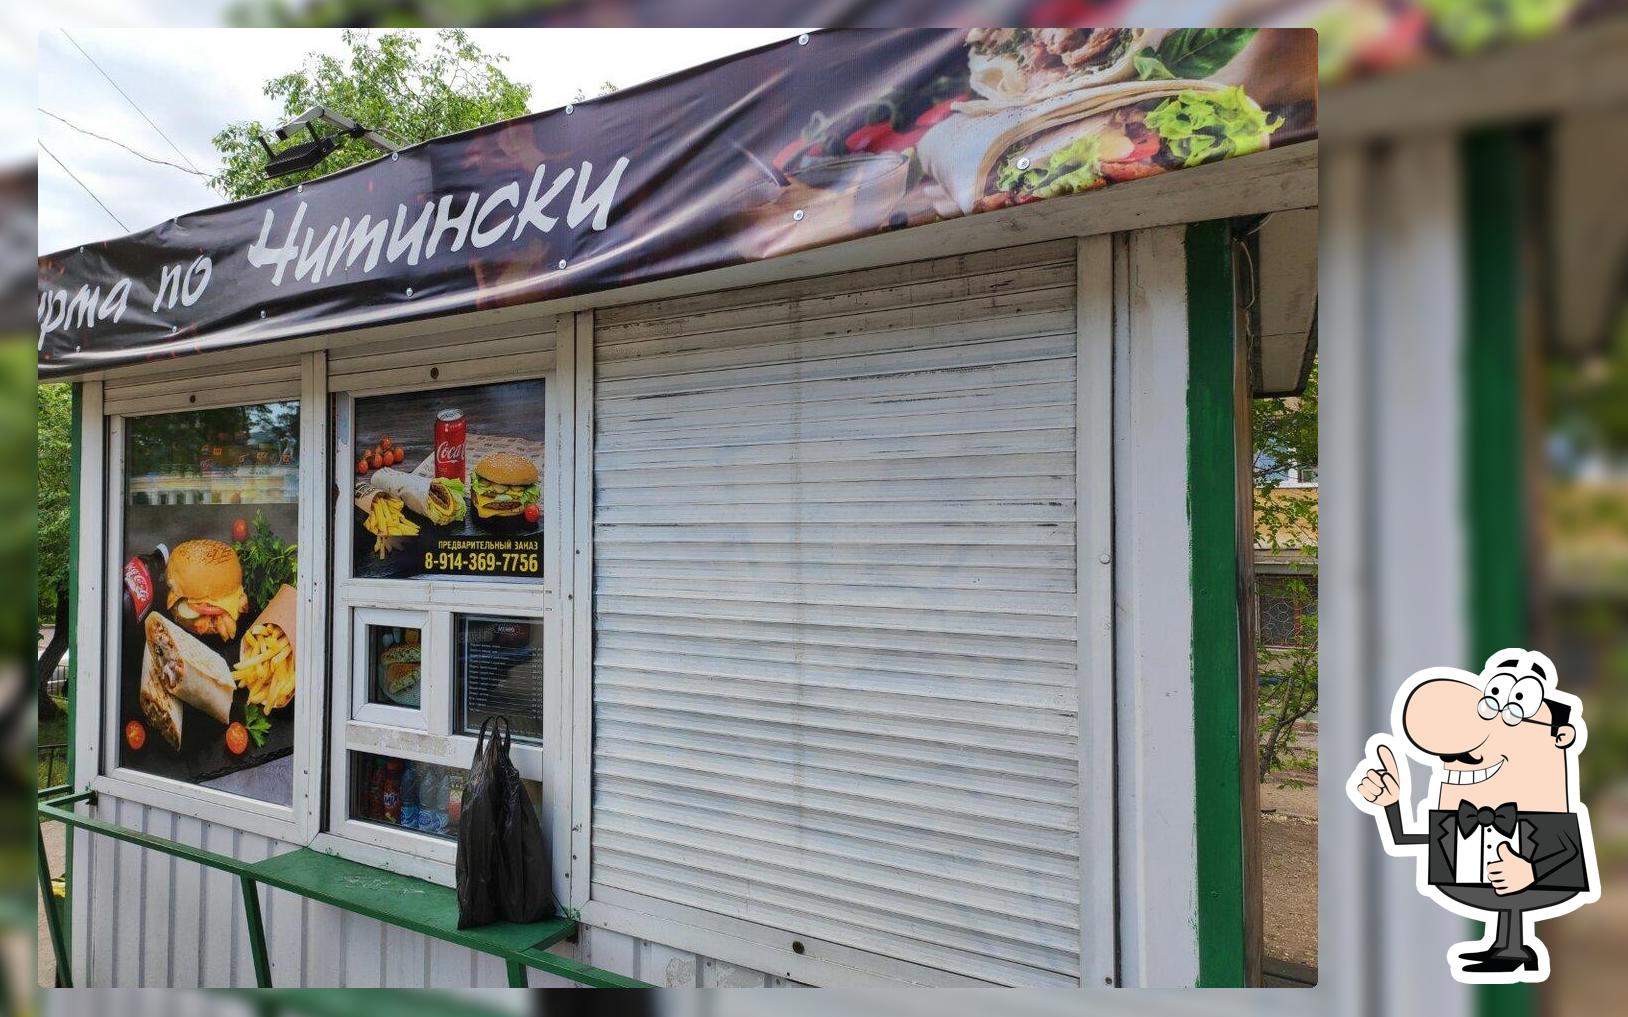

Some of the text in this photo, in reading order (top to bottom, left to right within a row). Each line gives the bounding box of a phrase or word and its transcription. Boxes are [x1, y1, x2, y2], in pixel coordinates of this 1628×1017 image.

[152, 255, 213, 313] по
[249, 156, 631, 286] Читински
[438, 540, 539, 550] ПРЕДВАРИТЕЛЬНЫЙ ЗАКАЗ
[424, 552, 538, 572] 8-914-369-7756
